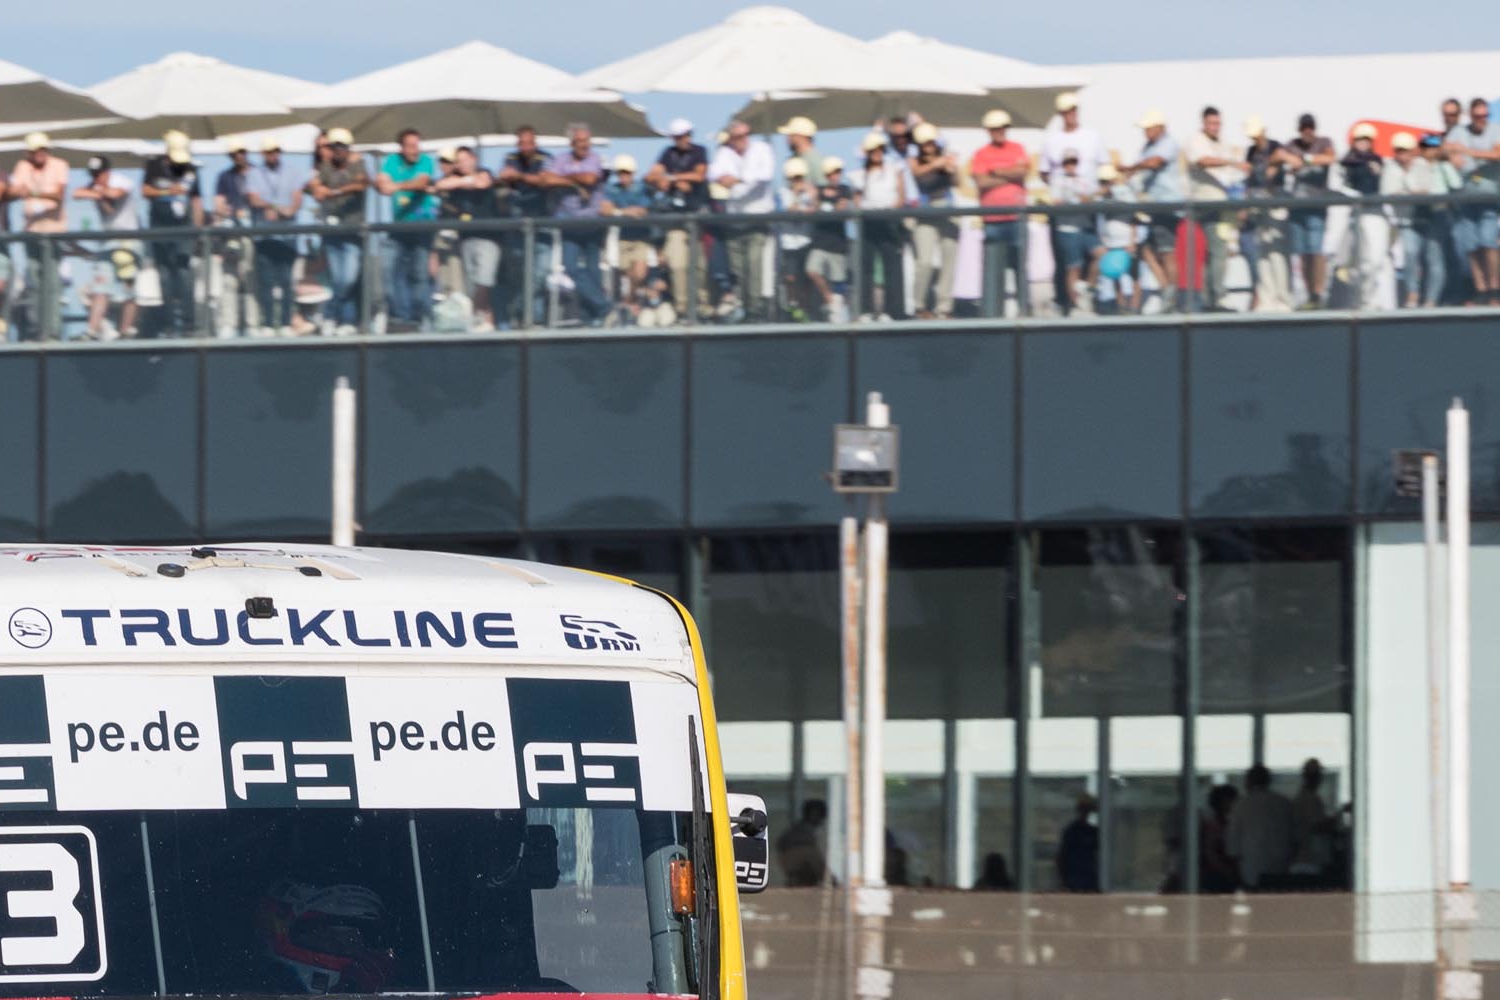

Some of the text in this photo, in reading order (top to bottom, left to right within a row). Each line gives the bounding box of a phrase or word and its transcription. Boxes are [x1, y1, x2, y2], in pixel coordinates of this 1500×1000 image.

[61, 608, 518, 648] TRUCKLINE
[67, 710, 200, 763] pe.de
[369, 710, 496, 761] pe.de
[229, 740, 355, 801] PE
[523, 742, 639, 801] PE
